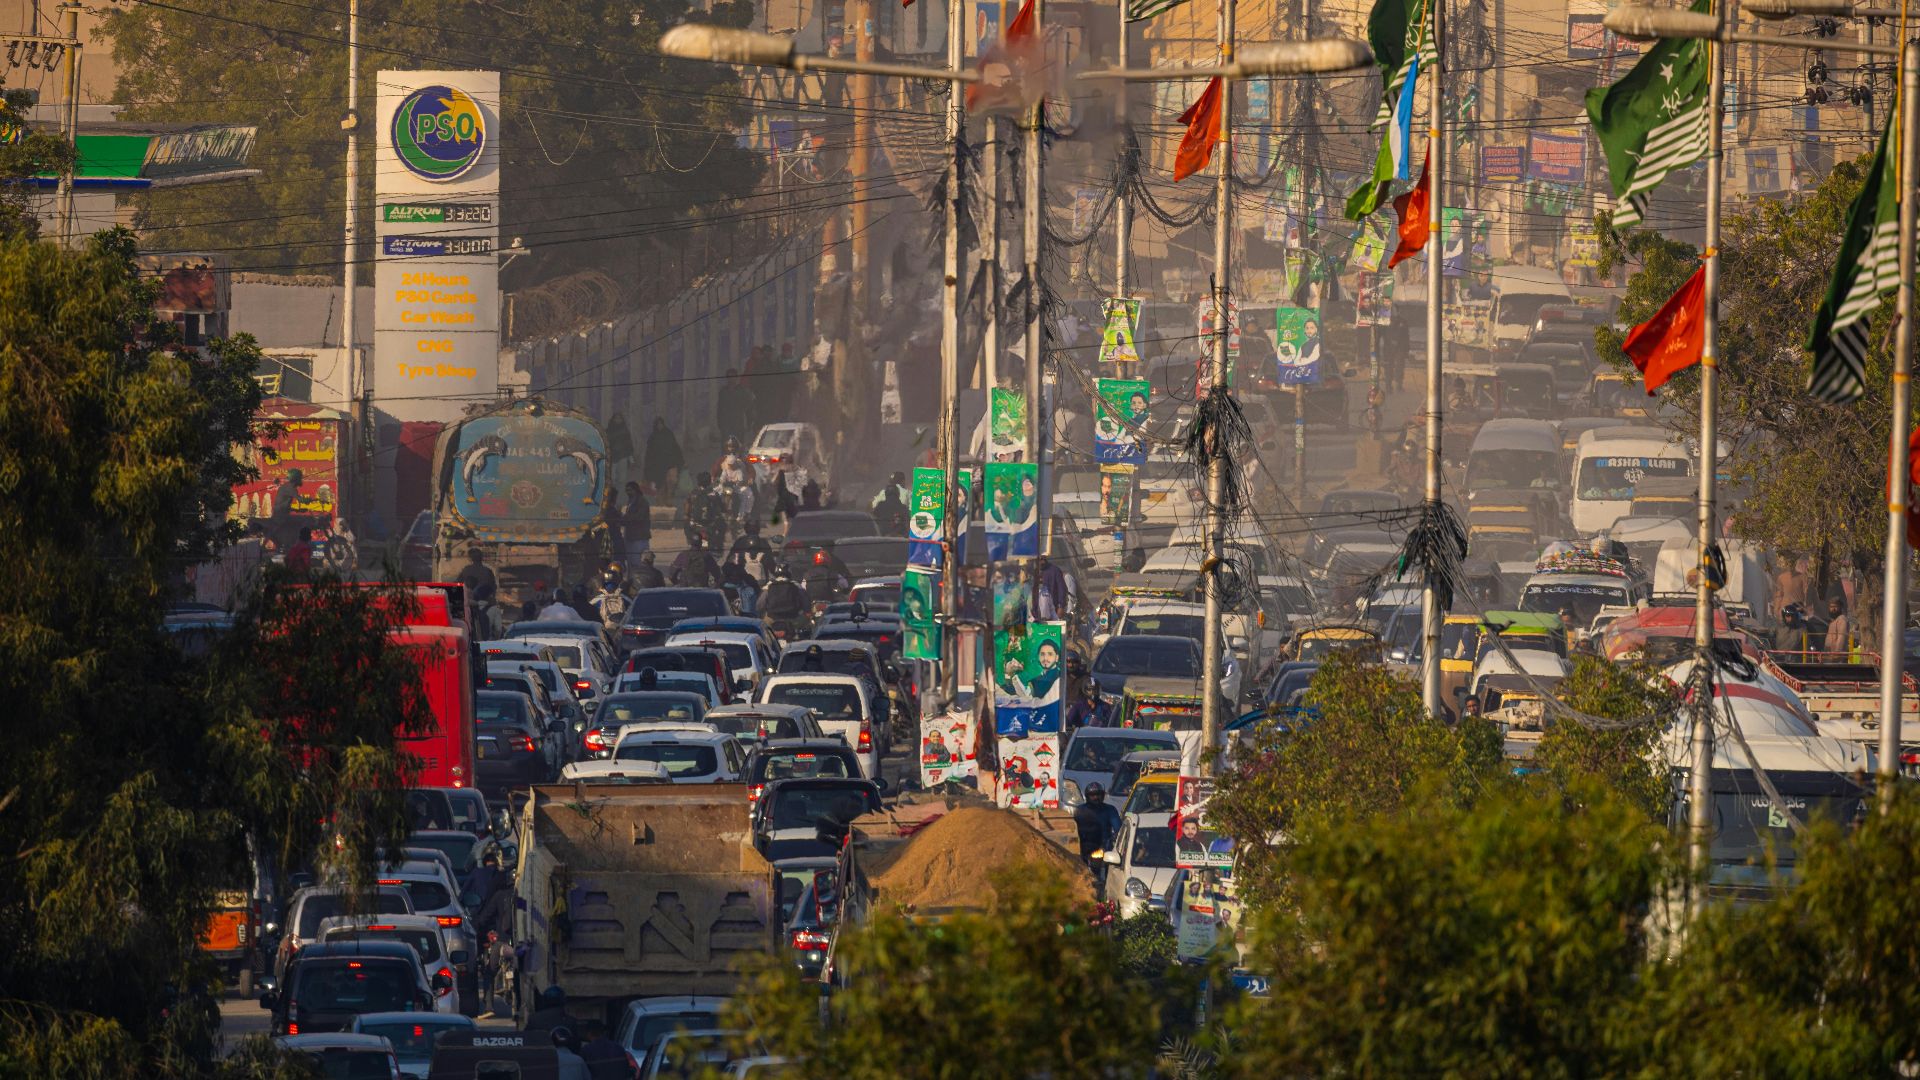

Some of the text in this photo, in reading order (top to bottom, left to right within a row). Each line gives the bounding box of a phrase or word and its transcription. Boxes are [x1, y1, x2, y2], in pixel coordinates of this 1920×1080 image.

[416, 112, 475, 143] PSO
[390, 206, 442, 219] ALTRON
[401, 272, 469, 287] 24 Hours
[395, 290, 478, 304] PSO Cards
[401, 310, 475, 324] Car Wash
[417, 339, 454, 353] CNG
[398, 362, 477, 380] Tyre Shop
[473, 1037, 524, 1047] SAZGAR
